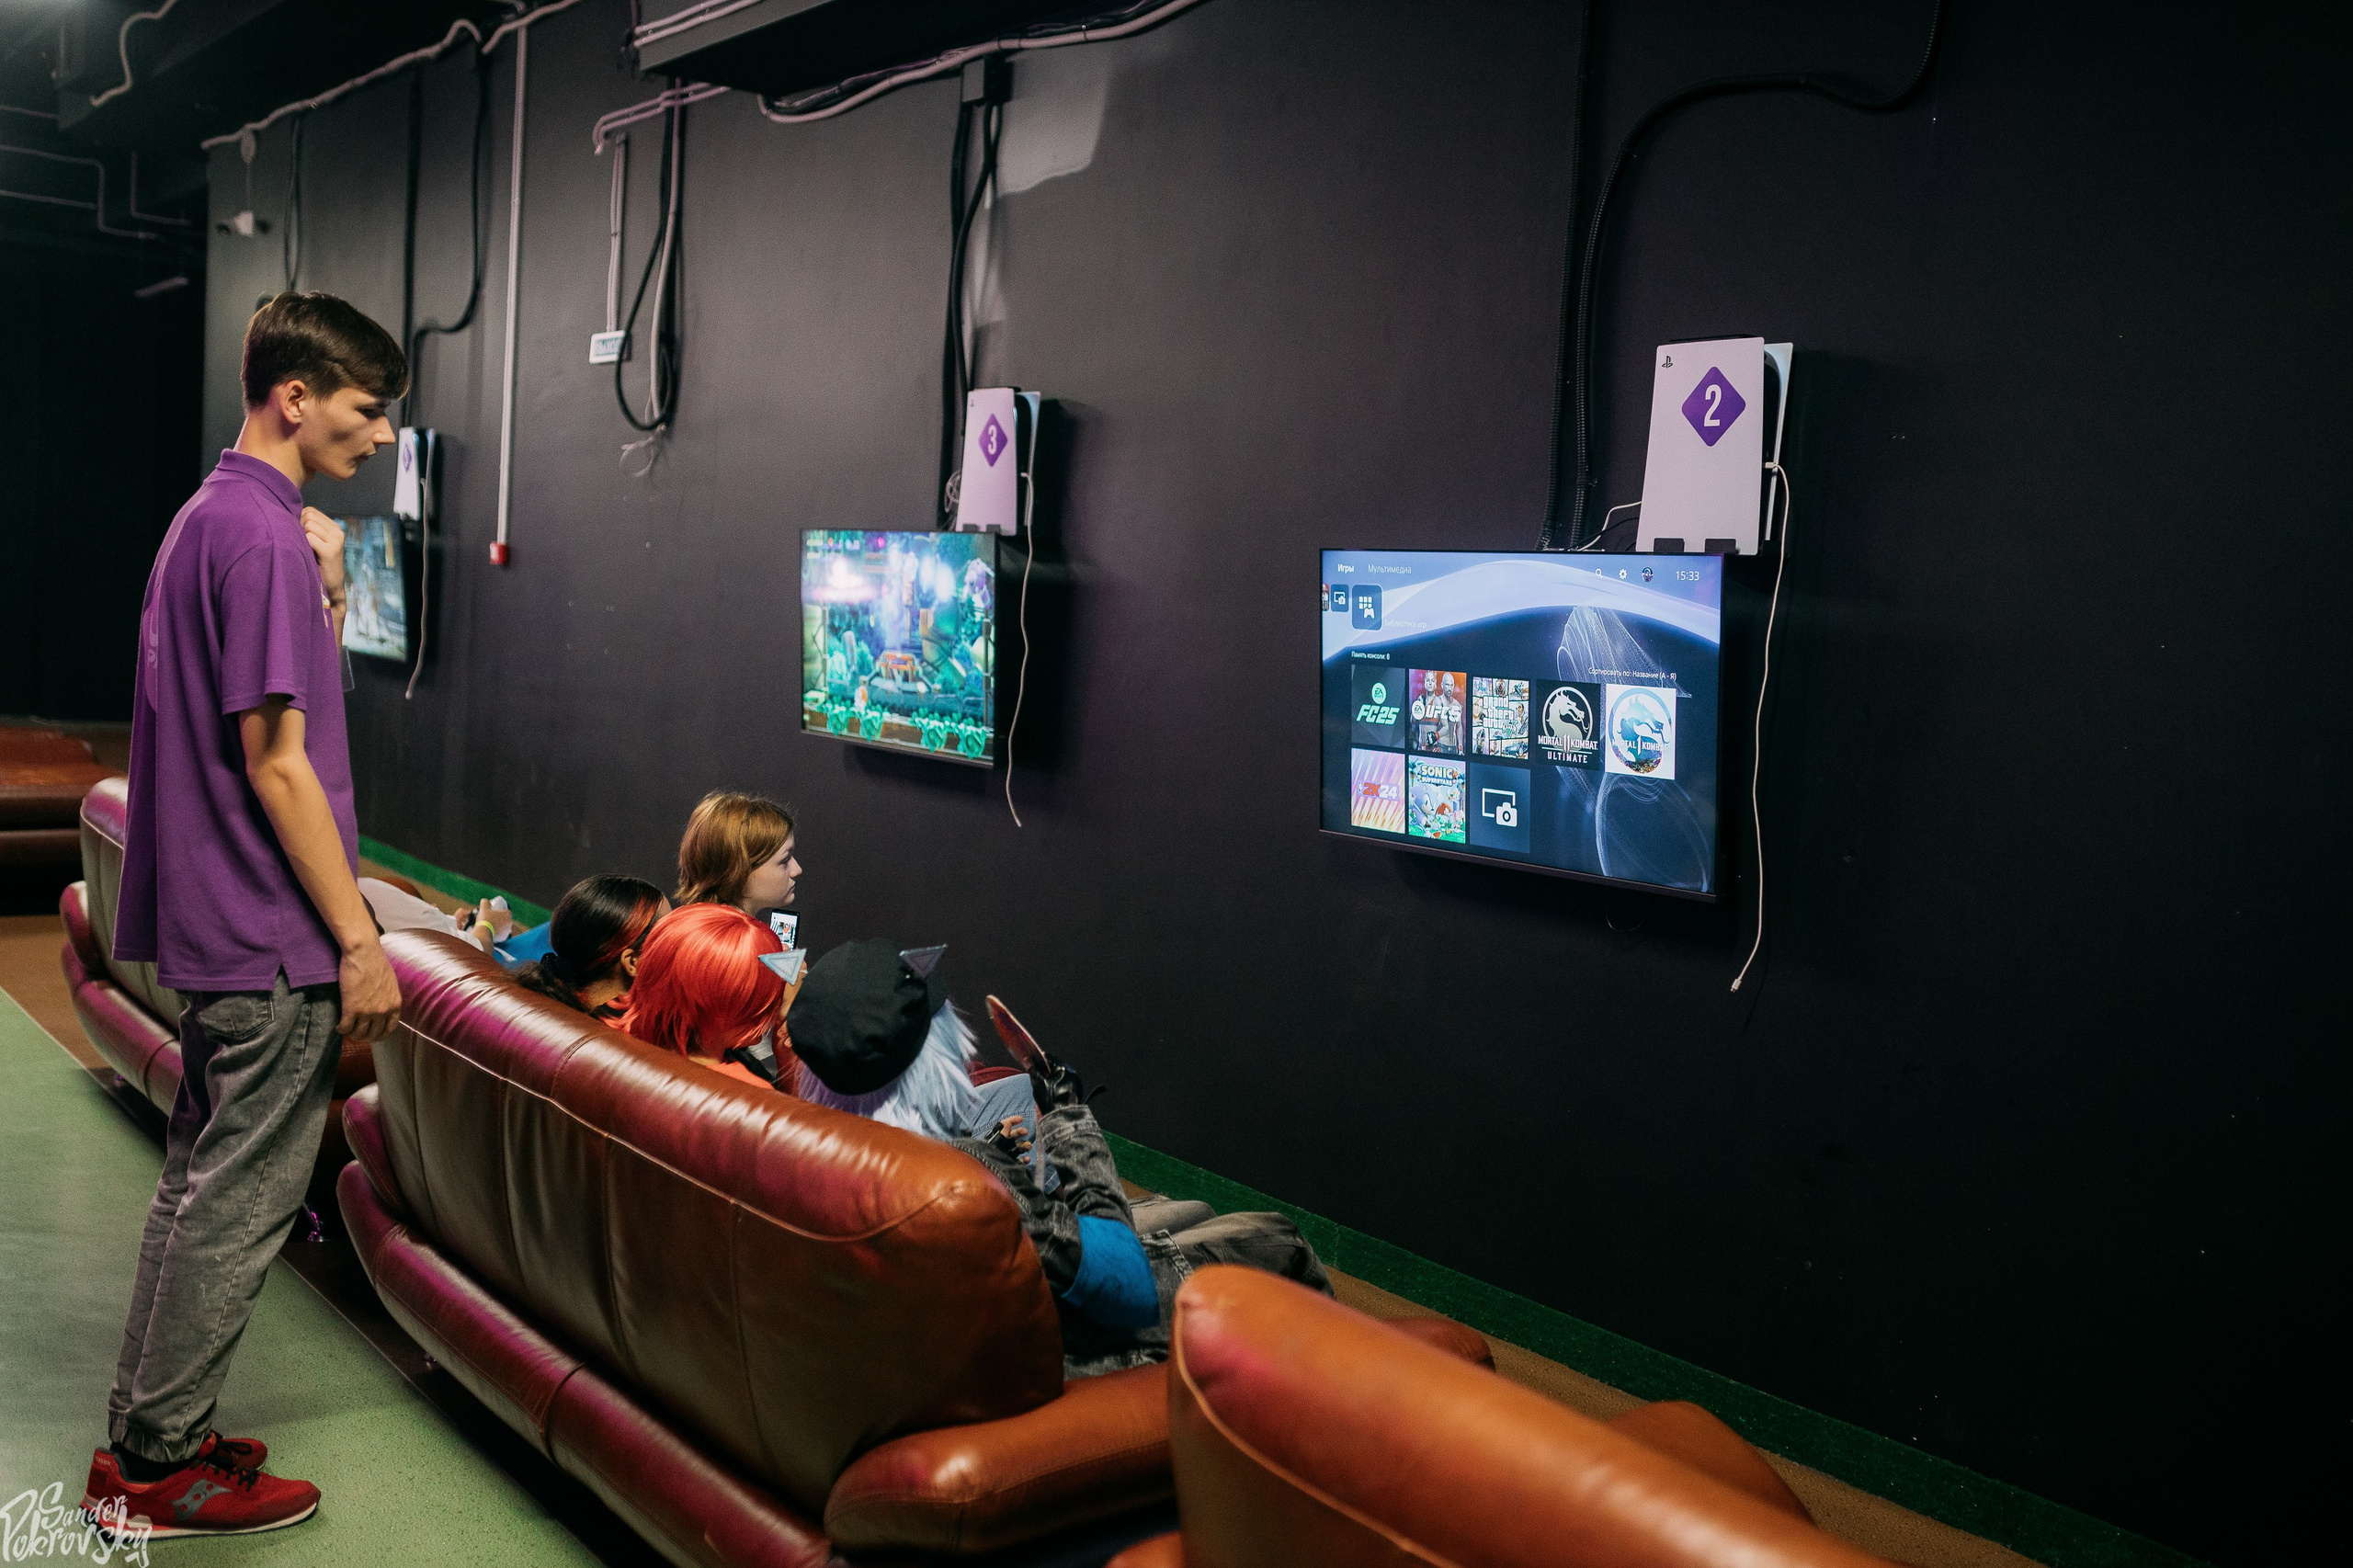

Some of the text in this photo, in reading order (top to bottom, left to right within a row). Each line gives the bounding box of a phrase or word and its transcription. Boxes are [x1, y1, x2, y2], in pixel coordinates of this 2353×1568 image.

[1703, 384, 1722, 427] 2
[988, 425, 997, 455] 3
[1337, 563, 1355, 574] Игры
[1368, 564, 1412, 574] Мультимедиа
[1676, 570, 1699, 581] 15:33
[1588, 667, 1622, 676] Сортировать
[1632, 671, 1658, 679] Название
[1538, 735, 1563, 746] MORTAL
[1571, 738, 1597, 750] KOMBAT
[1636, 735, 1642, 756] 1
[1547, 751, 1588, 764] ULTIMATE
[1421, 765, 1453, 778] SONIC
[1363, 782, 1398, 800] 2K24
